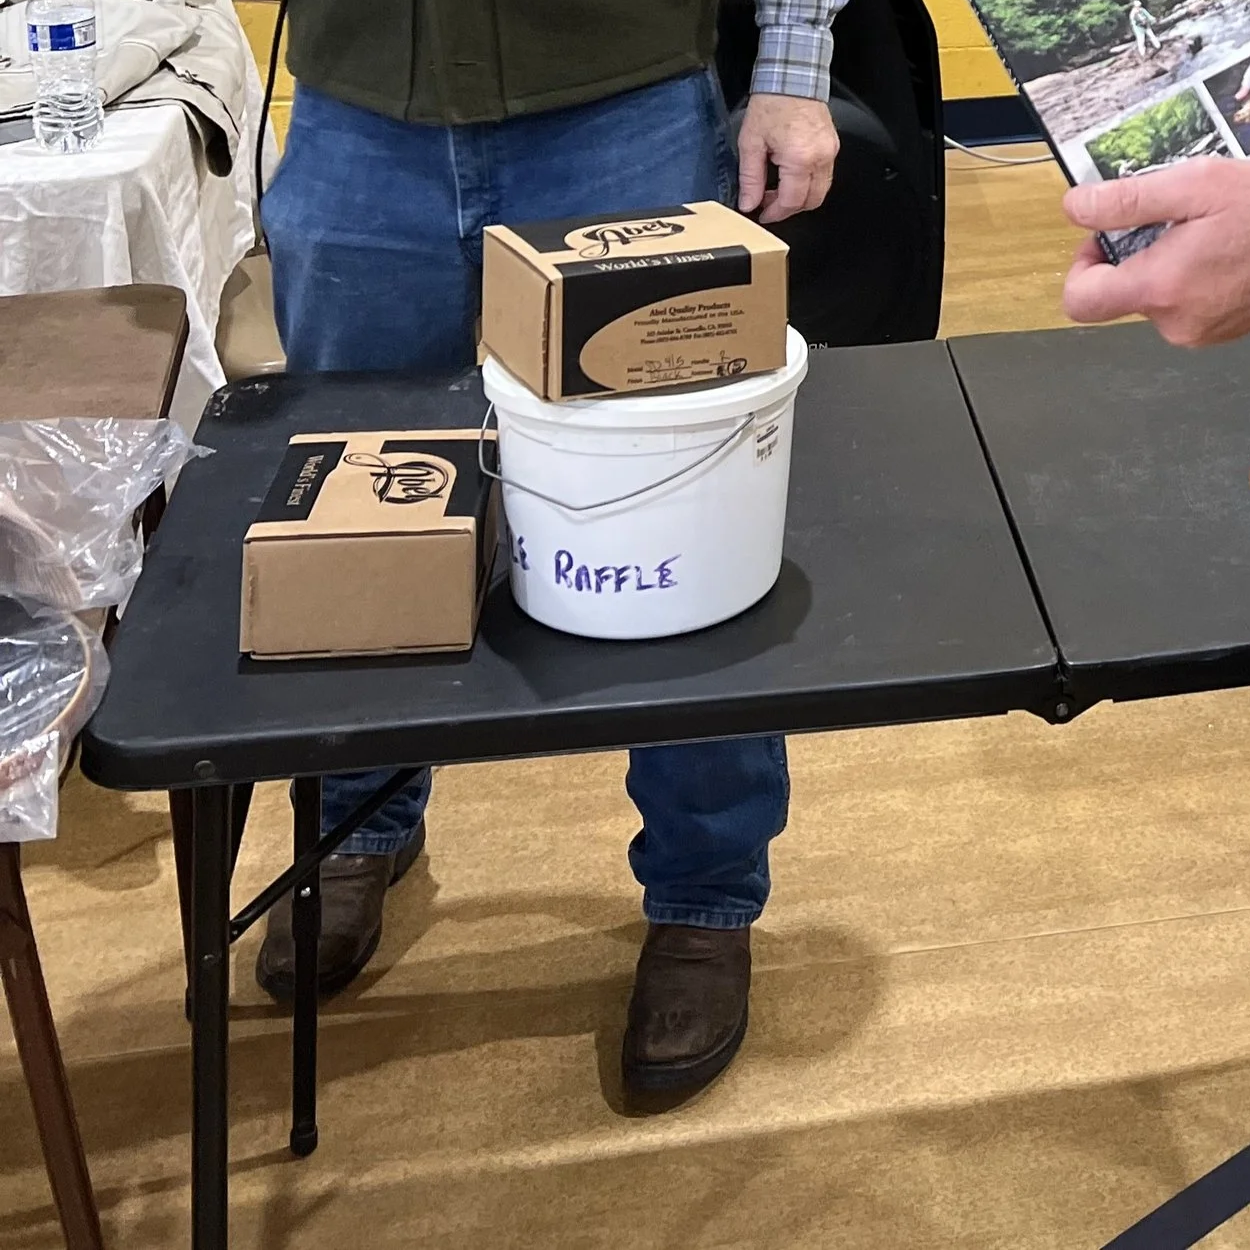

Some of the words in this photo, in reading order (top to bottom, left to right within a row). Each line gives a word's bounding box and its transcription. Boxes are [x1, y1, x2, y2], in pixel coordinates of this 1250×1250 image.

[579, 220, 674, 258] Abel
[594, 258, 660, 271] World's
[662, 252, 715, 265] Finest
[649, 308, 667, 317] Abel
[668, 305, 696, 315] Quality
[343, 453, 443, 503] Abel
[554, 549, 682, 594] RAFFLE
